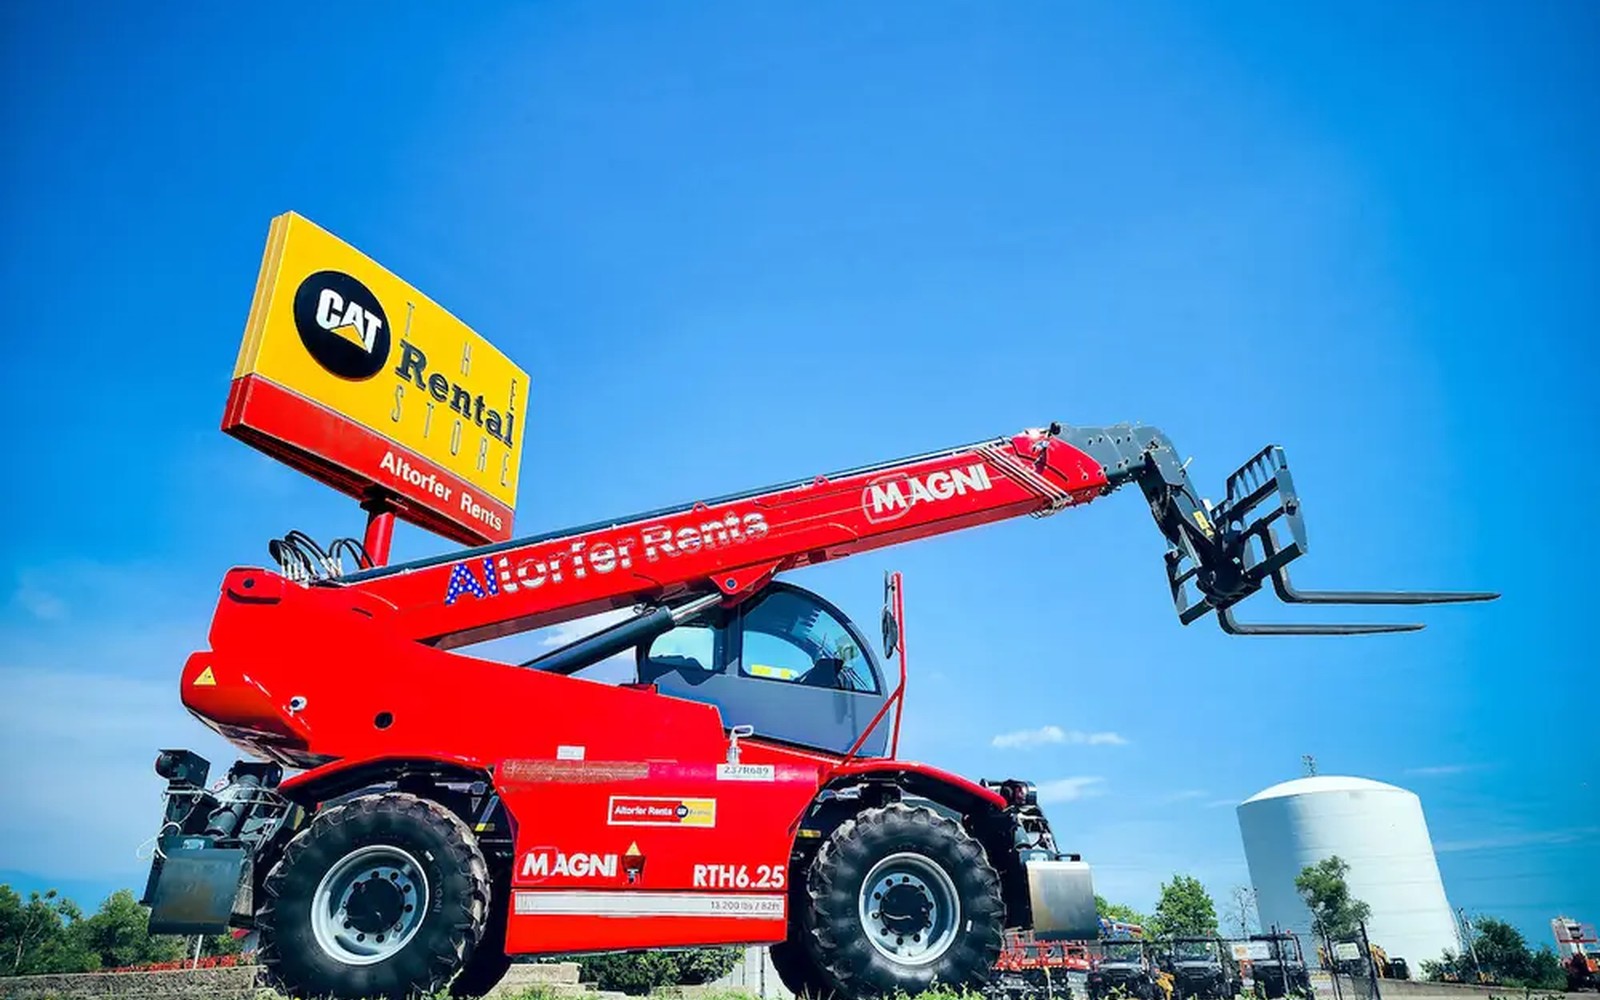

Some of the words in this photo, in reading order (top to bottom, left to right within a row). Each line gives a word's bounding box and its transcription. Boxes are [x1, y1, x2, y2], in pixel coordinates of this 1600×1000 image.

[316, 288, 382, 354] CAT
[406, 301, 517, 411] THE
[395, 338, 514, 448] Rental
[391, 384, 512, 487] STORE
[380, 451, 452, 502] Altorfer
[460, 492, 503, 531] Rents
[871, 463, 992, 513] MAGNI
[444, 537, 637, 606] Altorfer
[640, 511, 769, 562] Rents
[614, 805, 646, 815] Altorfer
[647, 806, 673, 816] Rents
[521, 852, 618, 877] MAGNI
[693, 864, 785, 888] RTH6.25
